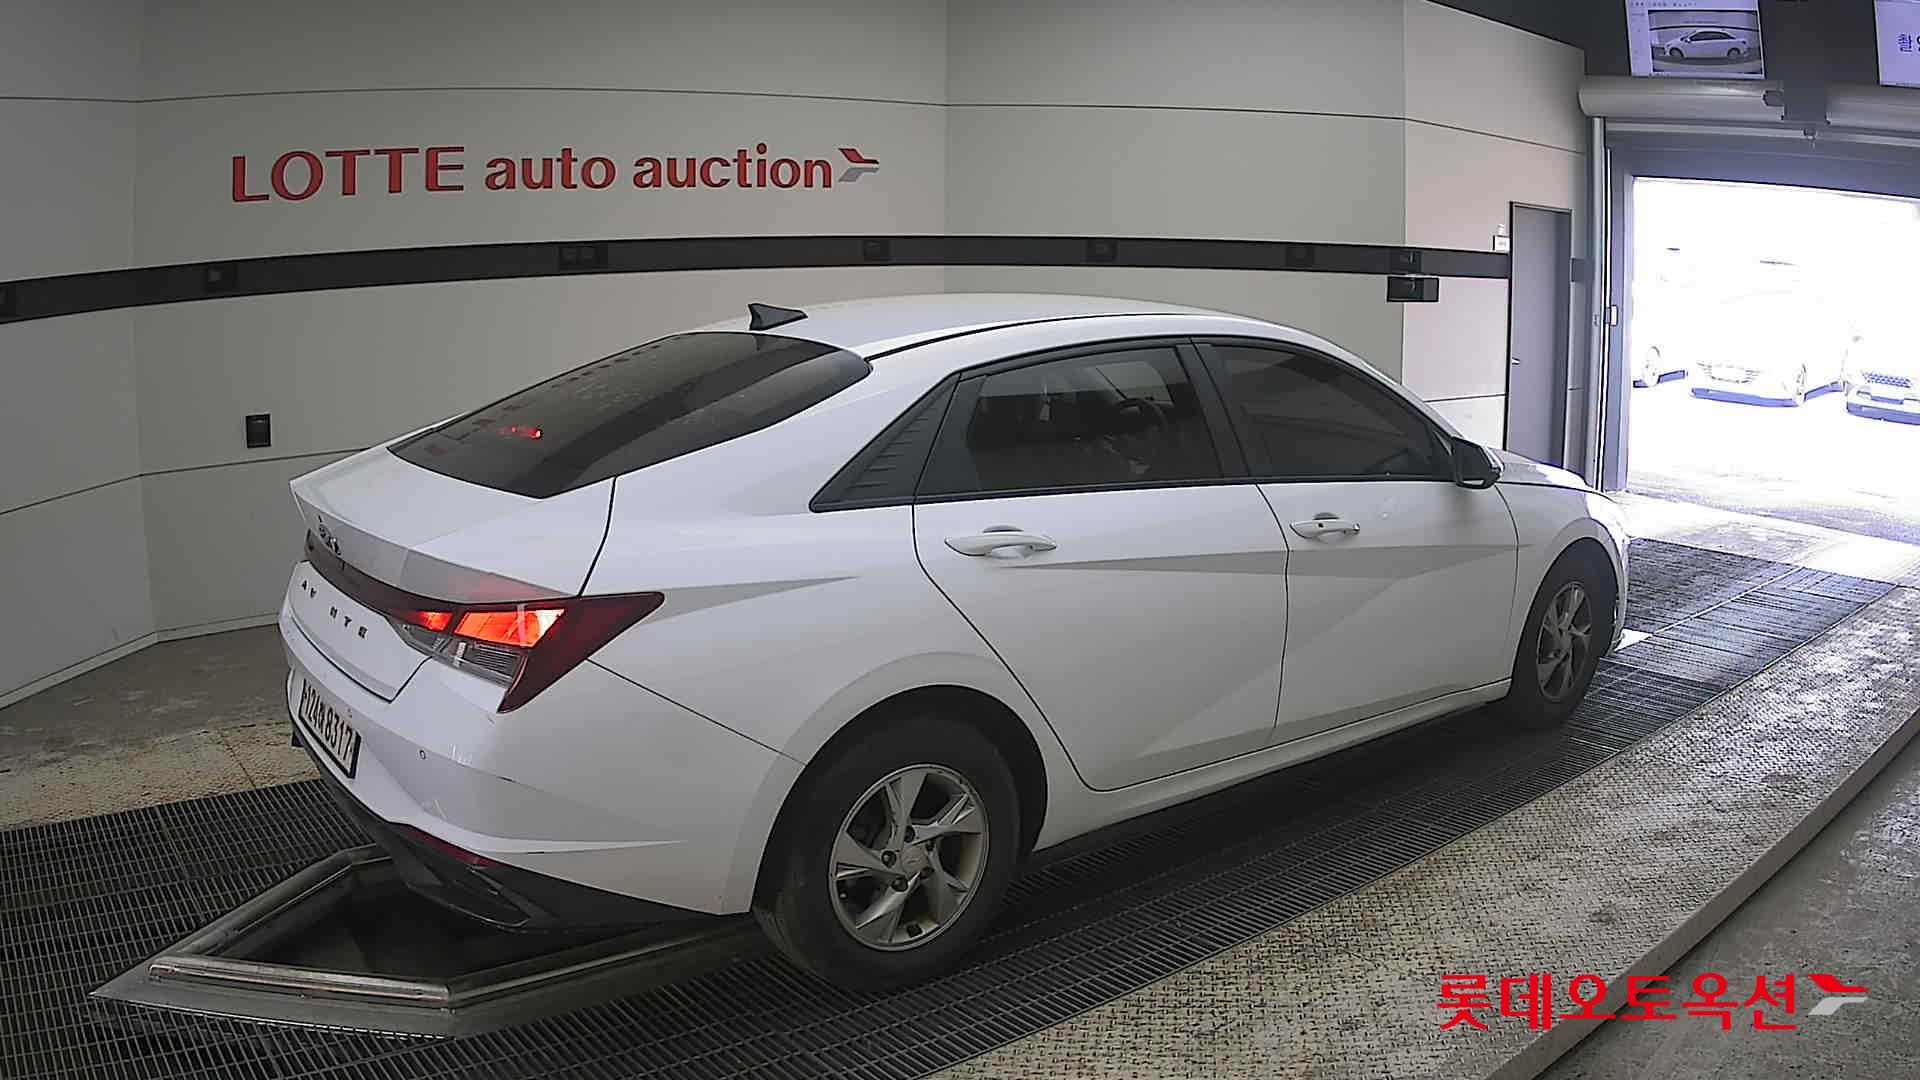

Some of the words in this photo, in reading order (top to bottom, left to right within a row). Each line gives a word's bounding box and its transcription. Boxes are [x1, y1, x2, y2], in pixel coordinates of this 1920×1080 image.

[1897, 32, 1920, 53] 촬
[232, 146, 465, 202] LOTTE
[485, 147, 617, 189] auto
[632, 143, 833, 188] auction
[301, 579, 368, 639] AVNTE
